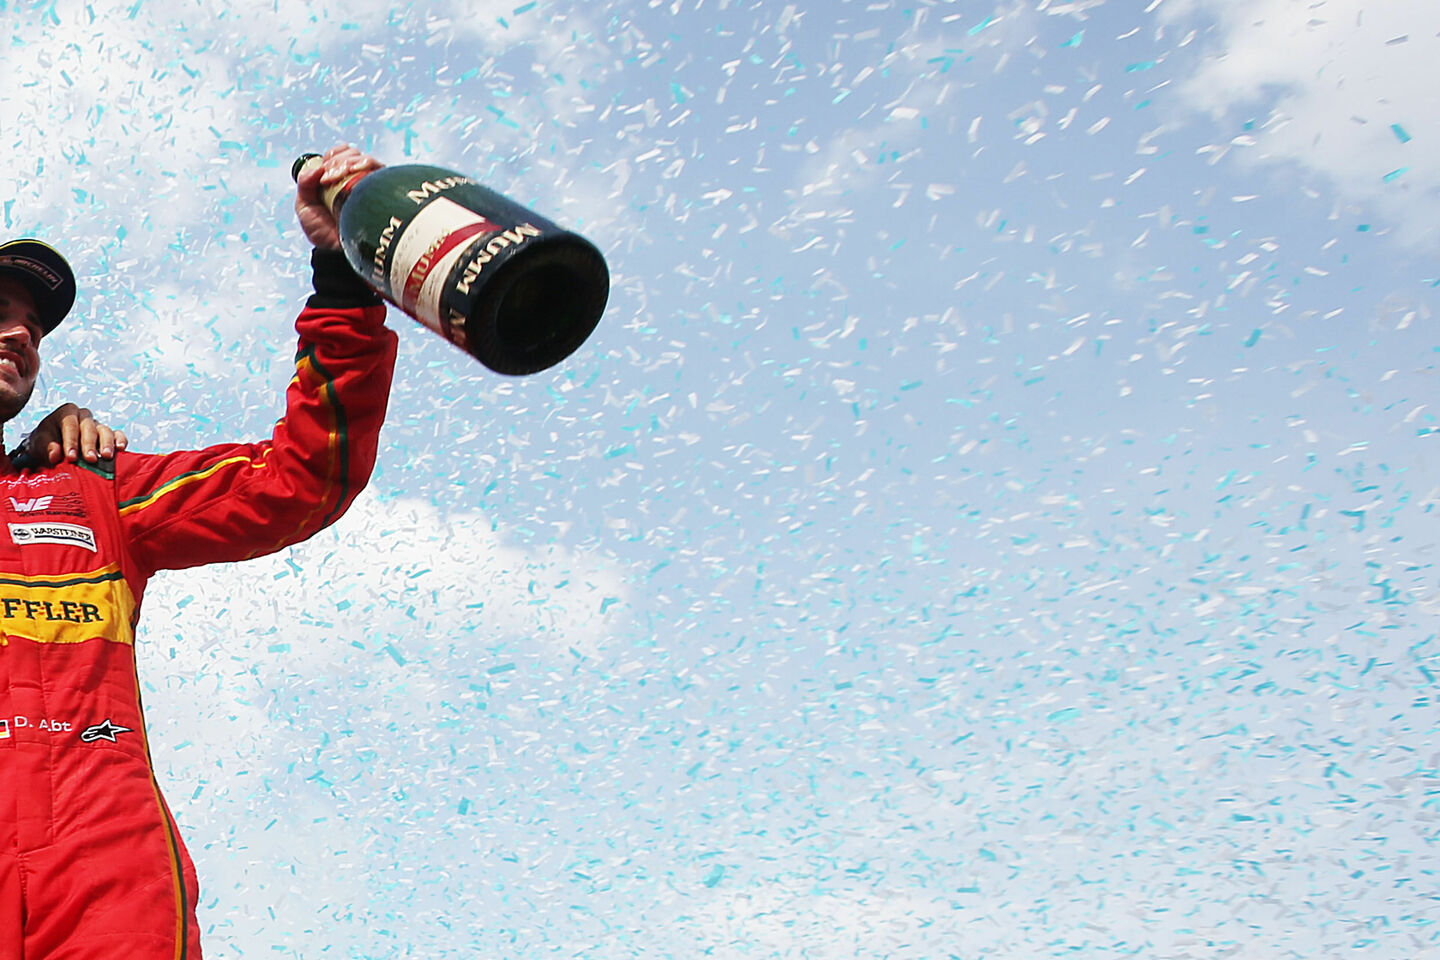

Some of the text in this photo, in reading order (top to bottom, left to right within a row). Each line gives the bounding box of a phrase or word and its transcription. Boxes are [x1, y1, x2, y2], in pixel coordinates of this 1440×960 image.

[408, 177, 477, 205] MUM
[456, 223, 542, 295] MUMM
[9, 496, 54, 512] WE
[15, 716, 73, 732] D. Abt
